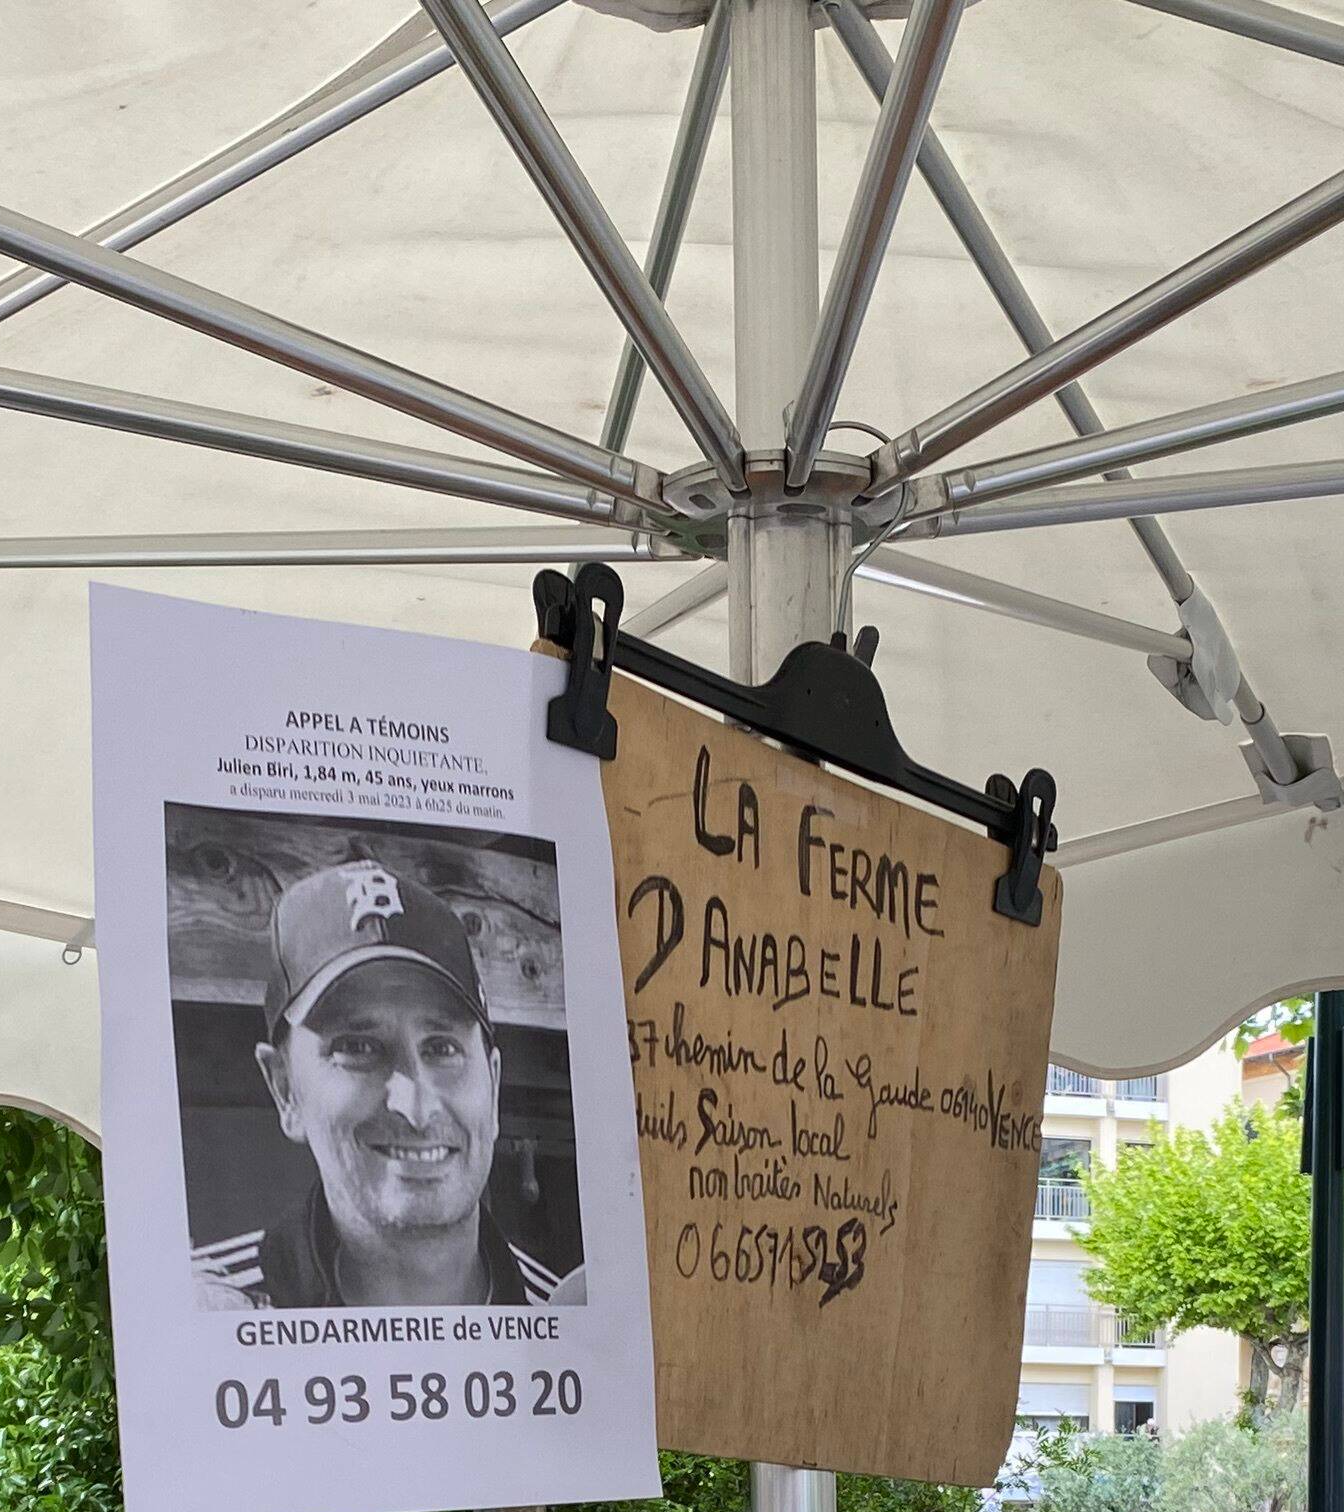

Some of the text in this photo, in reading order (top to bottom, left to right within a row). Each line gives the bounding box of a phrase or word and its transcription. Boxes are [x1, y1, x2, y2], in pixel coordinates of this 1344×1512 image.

[245, 734, 363, 760] DISPARITION
[286, 711, 449, 743] APPEL A TÉMOINS
[217, 757, 514, 801] Julien Biri, 1,84 m, 45 ans, yeux marrons
[240, 782, 285, 802] disparu
[290, 786, 343, 804] mercredi
[348, 790, 355, 804] 3
[358, 792, 381, 807] mai
[384, 795, 412, 810] 2023
[425, 797, 453, 813] 6h25
[456, 800, 470, 816] du
[693, 743, 945, 939] LA FERME
[700, 896, 920, 1016] ANABELLE
[772, 1028, 805, 1092] de
[814, 1035, 844, 1099] la
[791, 1099, 851, 1160] local
[689, 1166, 728, 1201] non
[236, 1315, 559, 1346] GENDARMERIE de VENCE
[215, 1369, 583, 1429] 04 93 58 03 20
